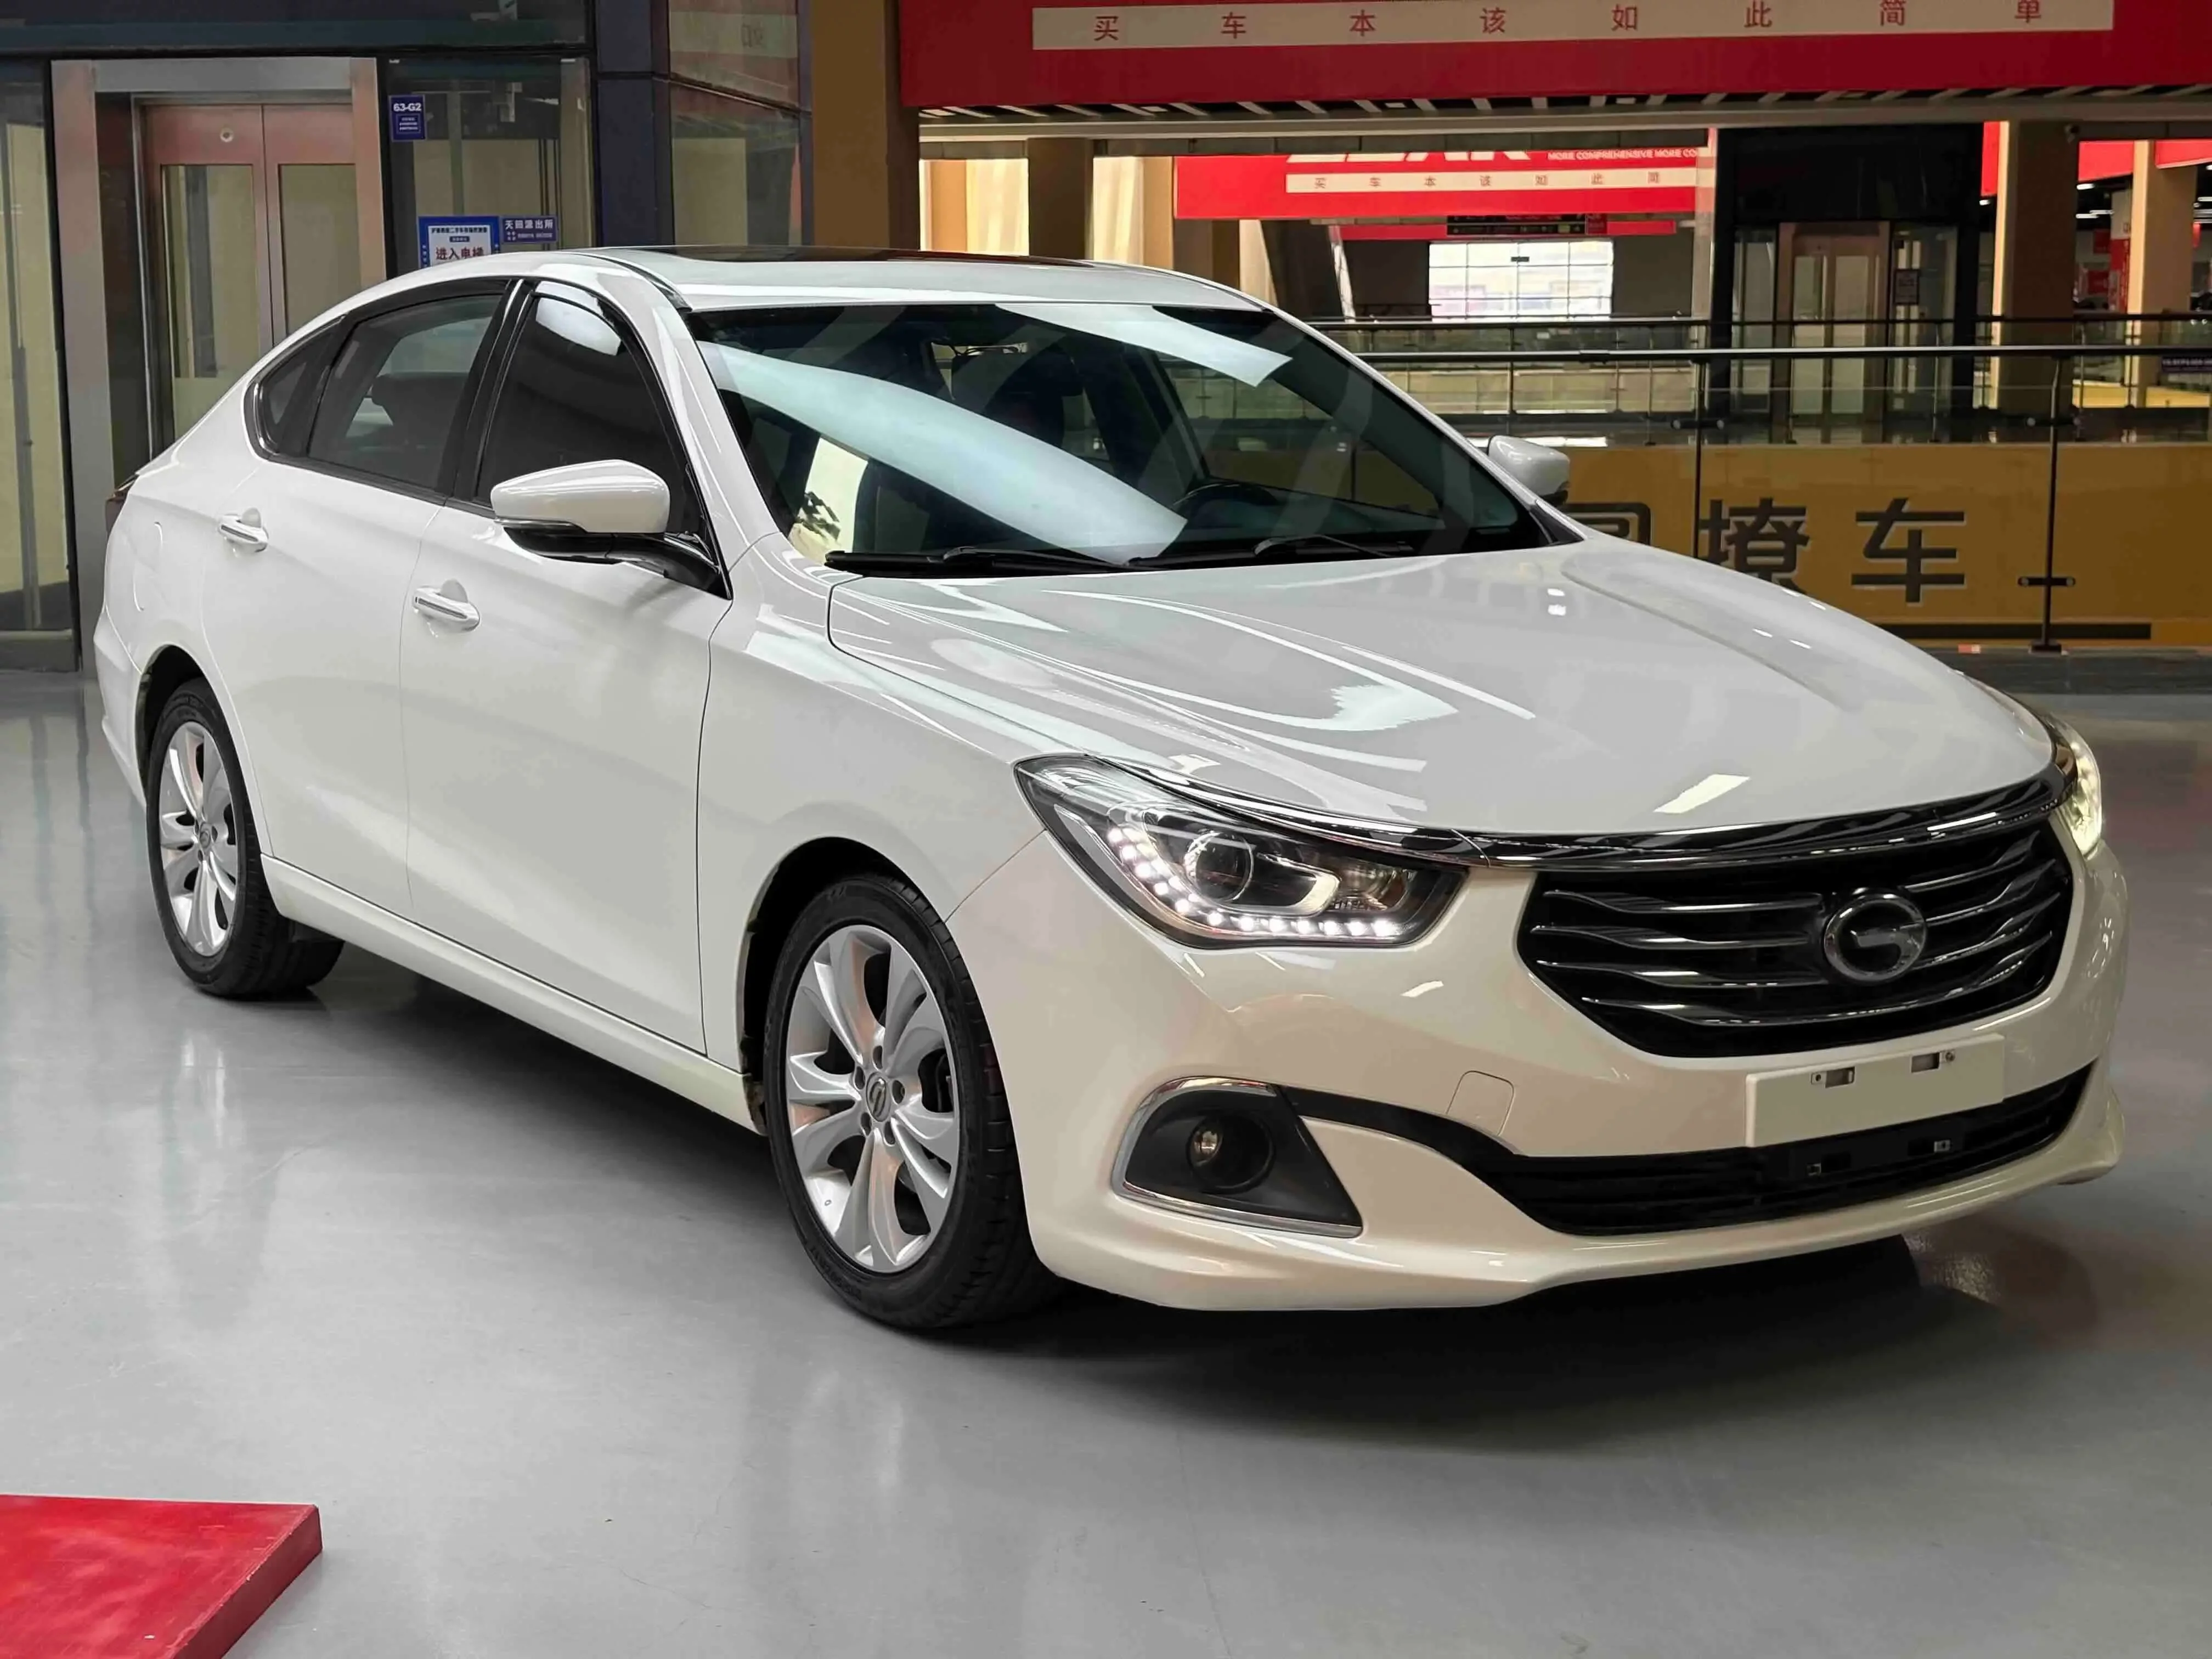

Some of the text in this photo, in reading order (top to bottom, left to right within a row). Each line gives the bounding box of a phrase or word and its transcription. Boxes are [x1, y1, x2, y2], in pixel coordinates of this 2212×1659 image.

[1093, 0, 2042, 41] 买车本该如此简单
[393, 103, 422, 112] 63-G2
